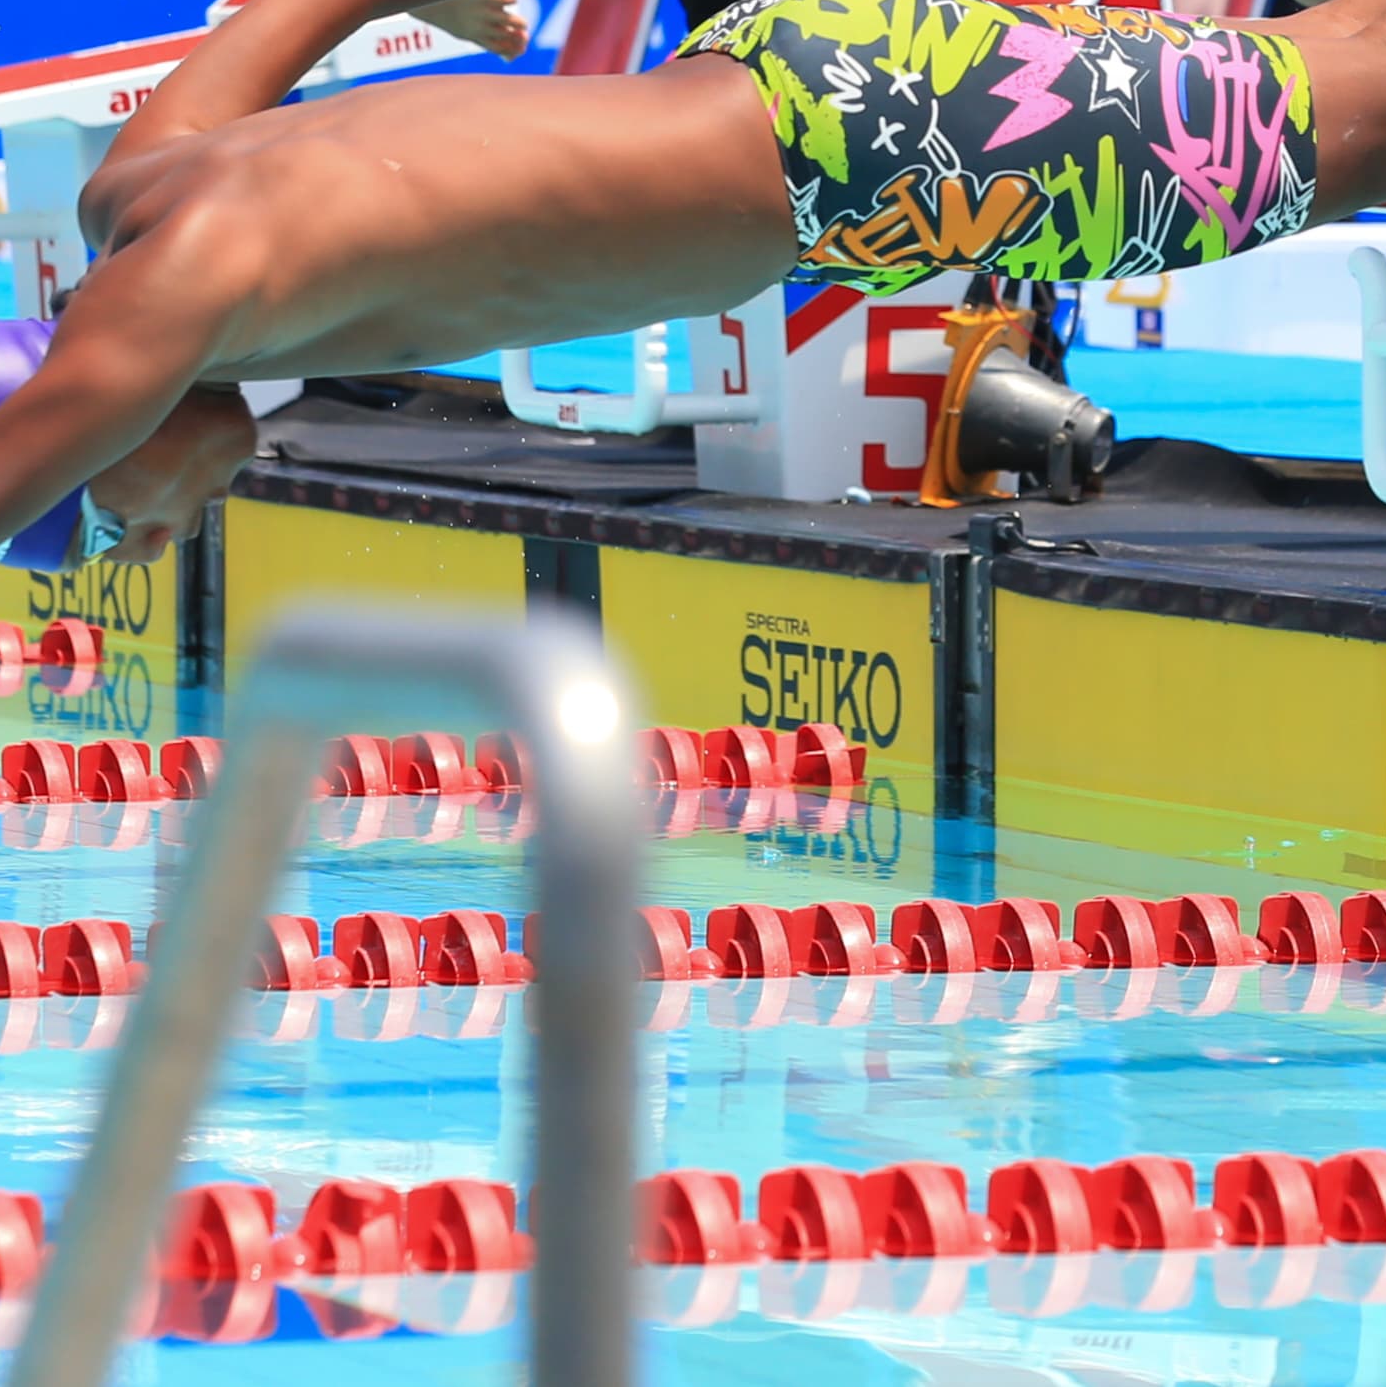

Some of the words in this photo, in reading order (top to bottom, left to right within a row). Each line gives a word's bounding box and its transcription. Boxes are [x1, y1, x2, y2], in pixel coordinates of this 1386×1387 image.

[376, 27, 432, 57] anti
[862, 306, 953, 491] 5
[29, 563, 151, 636] SEIKO
[746, 612, 810, 637] SPECTRA
[741, 634, 901, 748] SEIKO
